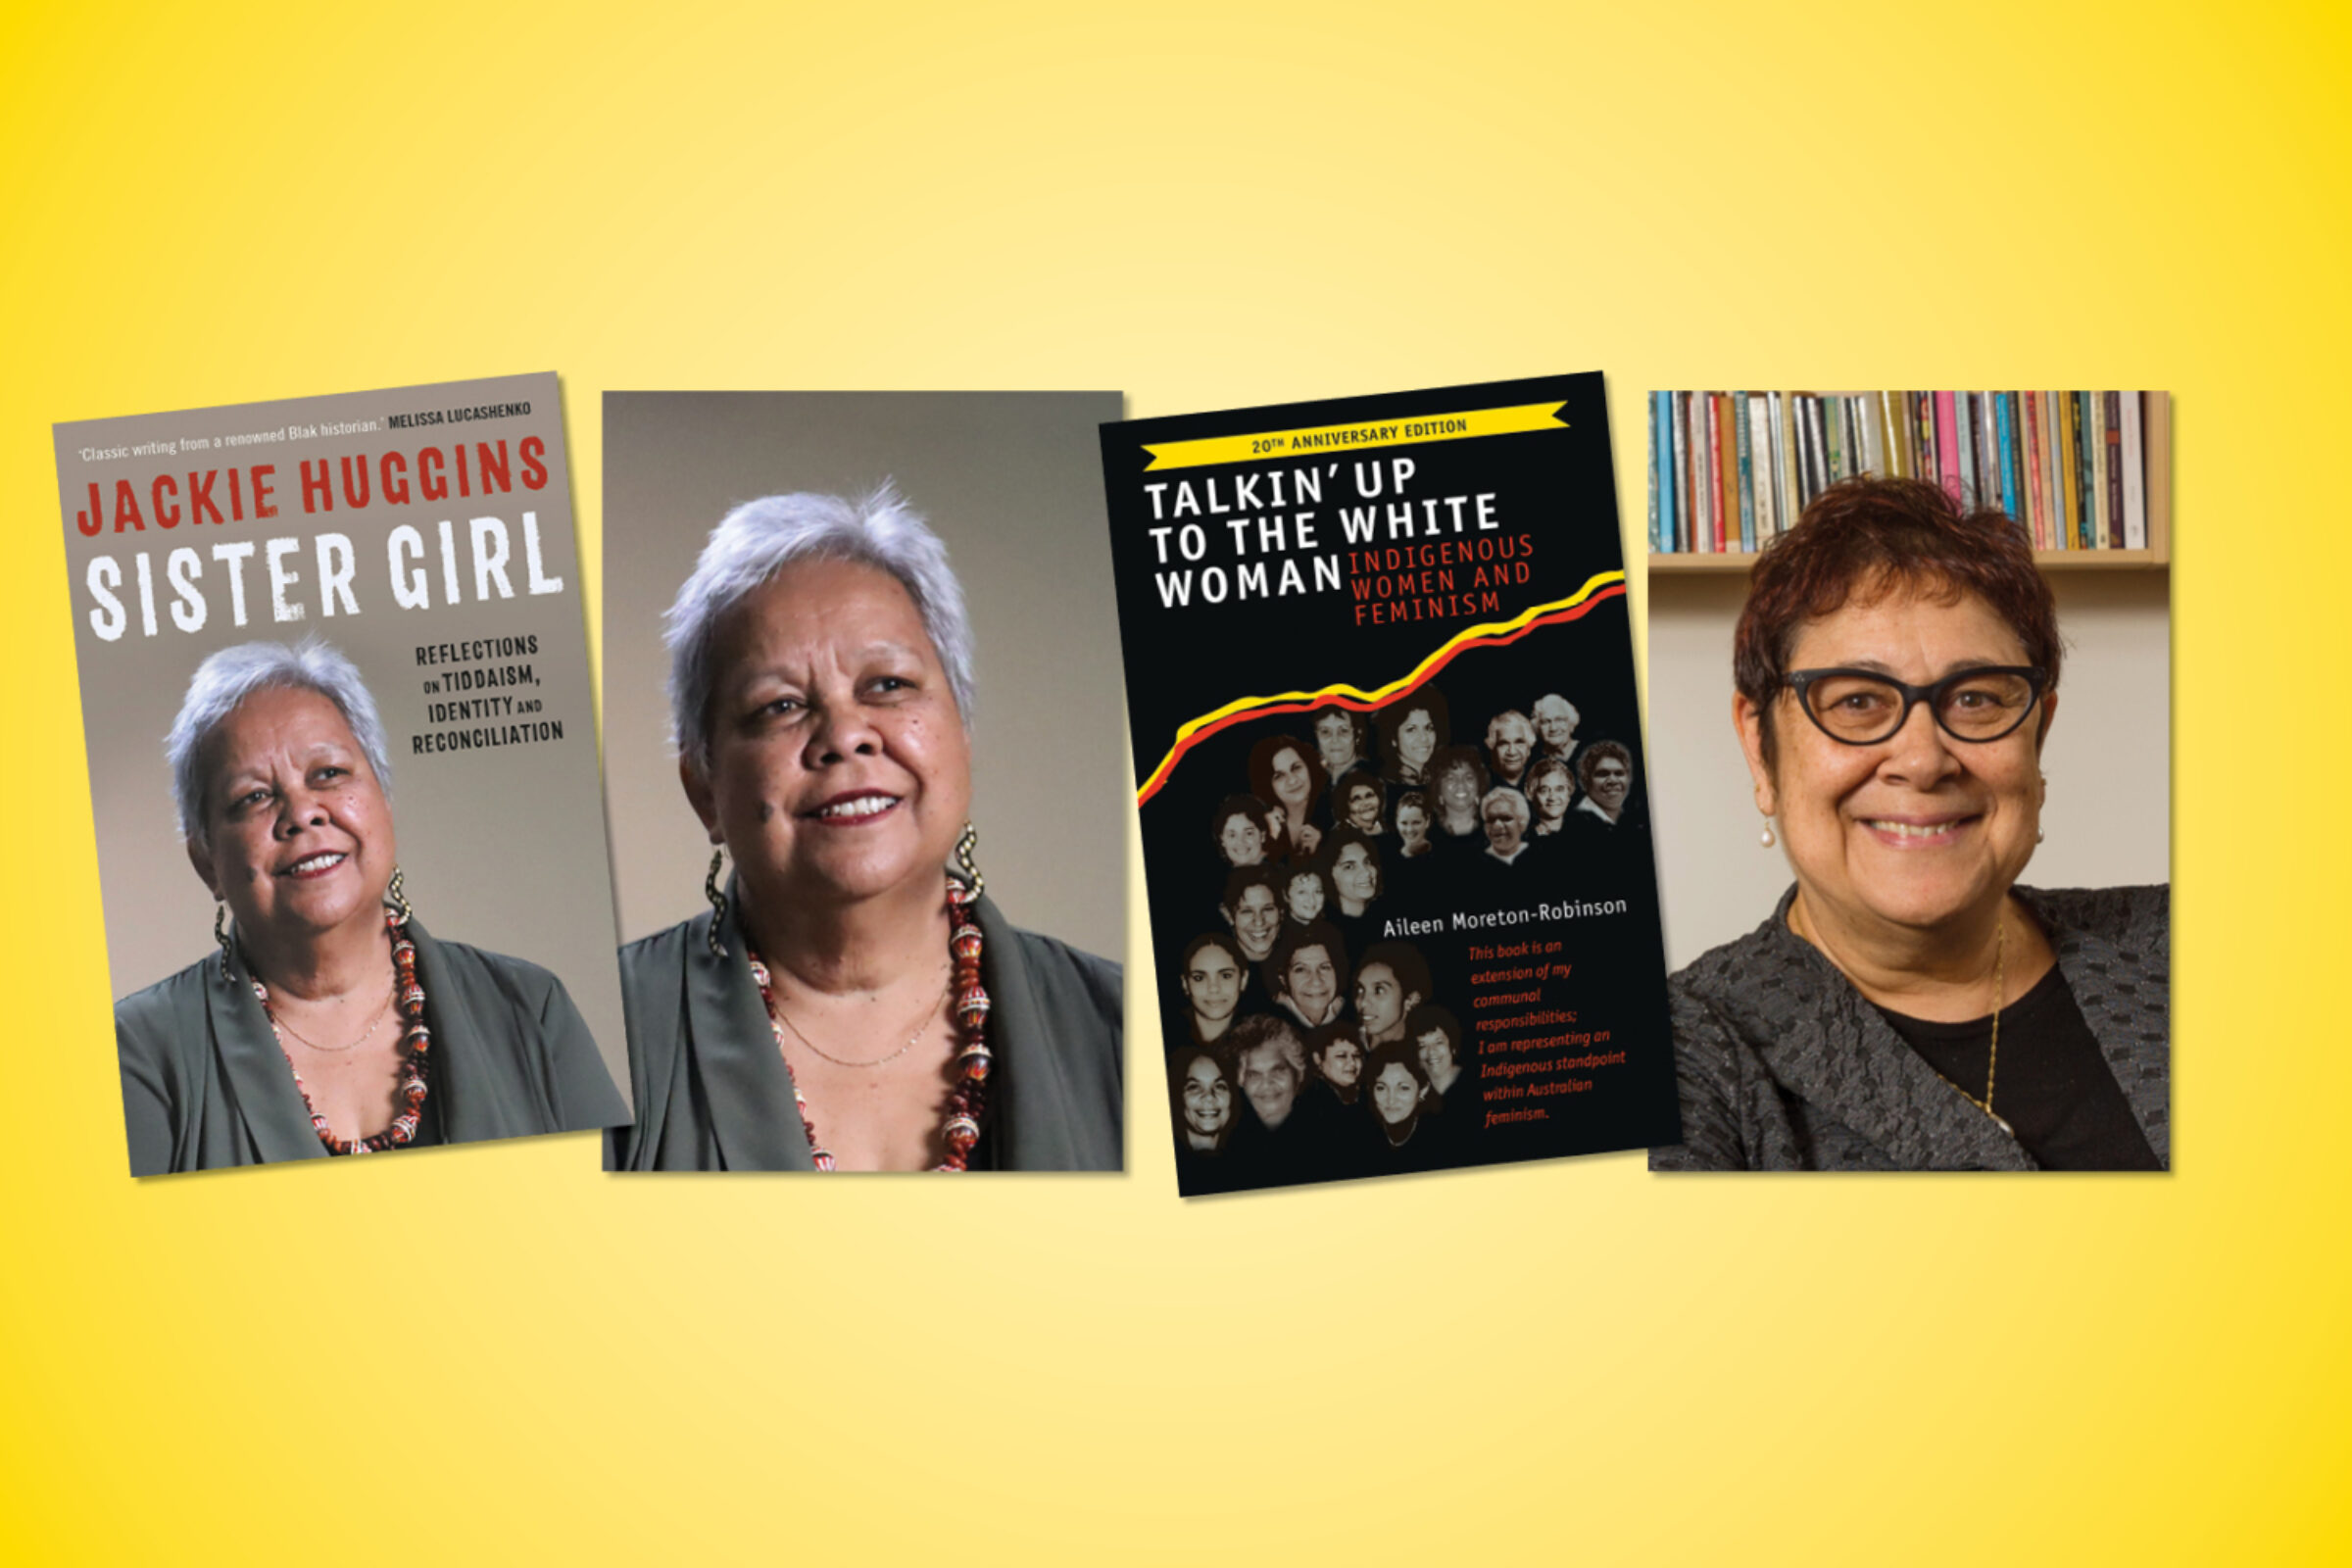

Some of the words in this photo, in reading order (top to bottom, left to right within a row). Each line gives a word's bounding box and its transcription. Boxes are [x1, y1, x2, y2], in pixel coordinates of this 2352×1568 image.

[132, 441, 176, 455] writing
[180, 436, 210, 451] from
[214, 438, 221, 448] a
[225, 427, 285, 447] renowned
[288, 423, 318, 440] Blak
[388, 410, 444, 429] MELISSA
[447, 401, 531, 423] LUCASHENKO
[1292, 425, 1398, 449] ANNIVERSARY
[1404, 418, 1467, 437] EDITION
[76, 465, 278, 536] JACKIE
[300, 435, 549, 514] HUGGINS
[1355, 458, 1416, 499] UP
[1149, 525, 1206, 564] TO
[1227, 512, 1318, 556] THE
[1339, 493, 1498, 544] WHITE
[1348, 534, 1534, 574] INDIGENOUS
[86, 532, 361, 642] SISTER
[387, 511, 564, 610] GIRL
[1155, 555, 1342, 608] WOMAN
[1350, 568, 1454, 601] WOMEN
[1474, 562, 1530, 588] AND
[1354, 591, 1499, 626] FEMINISM
[416, 634, 538, 666] REFLECTIONS
[423, 680, 440, 694] ON
[442, 664, 540, 692] TIDDAISM,
[427, 696, 513, 723] IDENTITY
[517, 699, 543, 714] AND
[413, 720, 564, 755] RECONCILIATION
[1384, 917, 1444, 938] Aileen
[1452, 899, 1627, 930] Moreton-Robinson
[1469, 945, 1494, 961] This
[1497, 944, 1529, 958] book
[1532, 941, 1543, 955] is
[1545, 941, 1563, 954] an
[1471, 966, 1533, 985] extension
[1536, 962, 1550, 980] of
[1552, 964, 1572, 979] my
[1473, 987, 1542, 1008] communal
[1476, 1009, 1577, 1033] responsibilities;
[1478, 1040, 1485, 1054] I
[1488, 1041, 1507, 1054] am
[1511, 1031, 1591, 1053] representing
[1593, 1030, 1610, 1043] an
[1481, 1061, 1553, 1079] Indigenous
[1556, 1051, 1626, 1070] standpoint
[1483, 1083, 1524, 1102] within
[1527, 1078, 1592, 1098] Australian
[1484, 1106, 1549, 1129] feminism.
